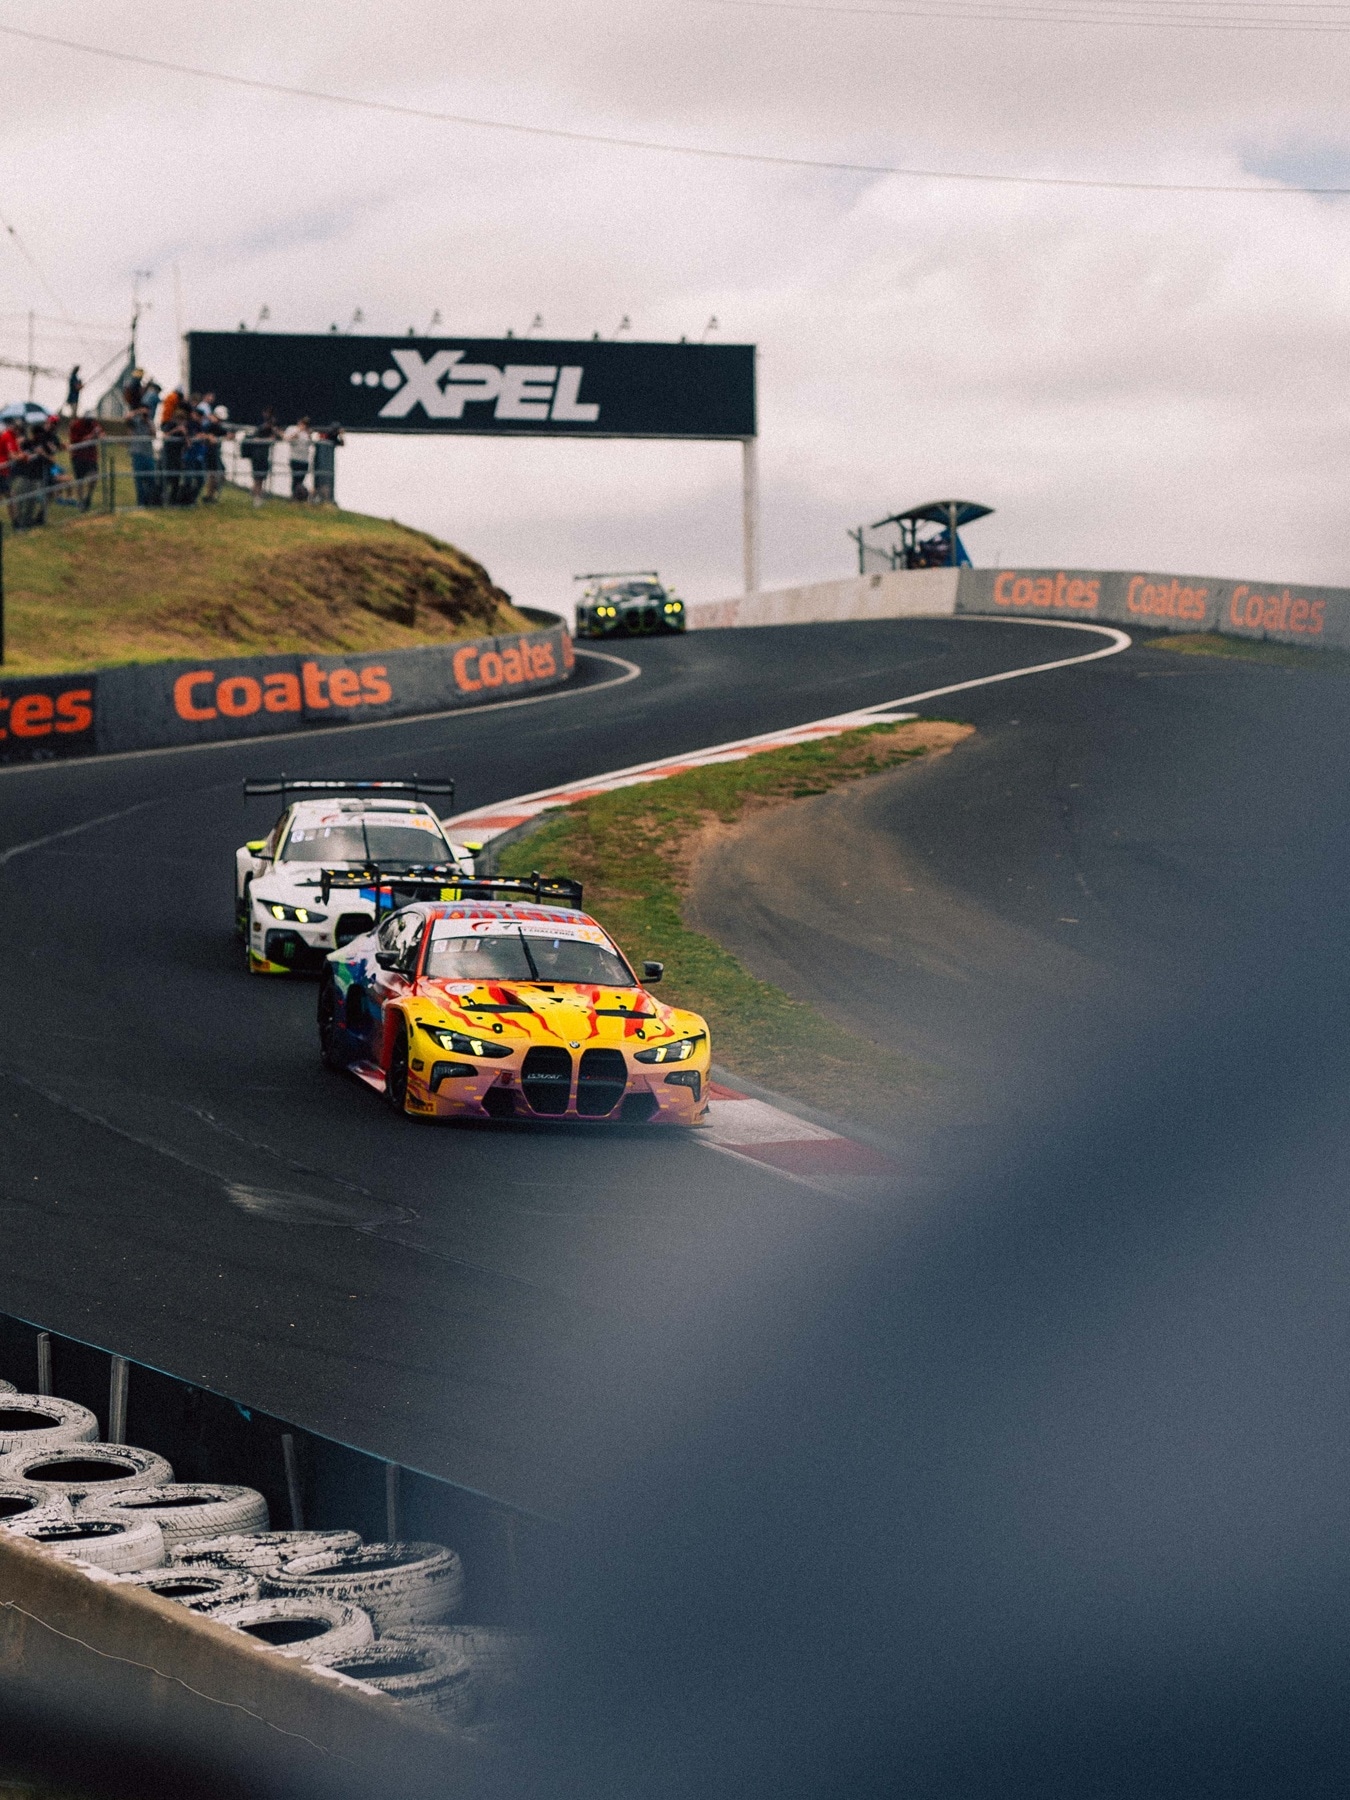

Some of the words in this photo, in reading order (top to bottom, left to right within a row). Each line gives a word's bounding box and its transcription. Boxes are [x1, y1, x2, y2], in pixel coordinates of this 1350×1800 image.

[378, 350, 600, 422] XPEL
[993, 571, 1101, 610] Coates
[1126, 576, 1209, 620] Coates
[1230, 585, 1326, 635] Coates
[452, 638, 557, 692] Coates
[0, 688, 94, 739] es
[173, 661, 393, 722] Coates
[577, 928, 605, 944] 32
